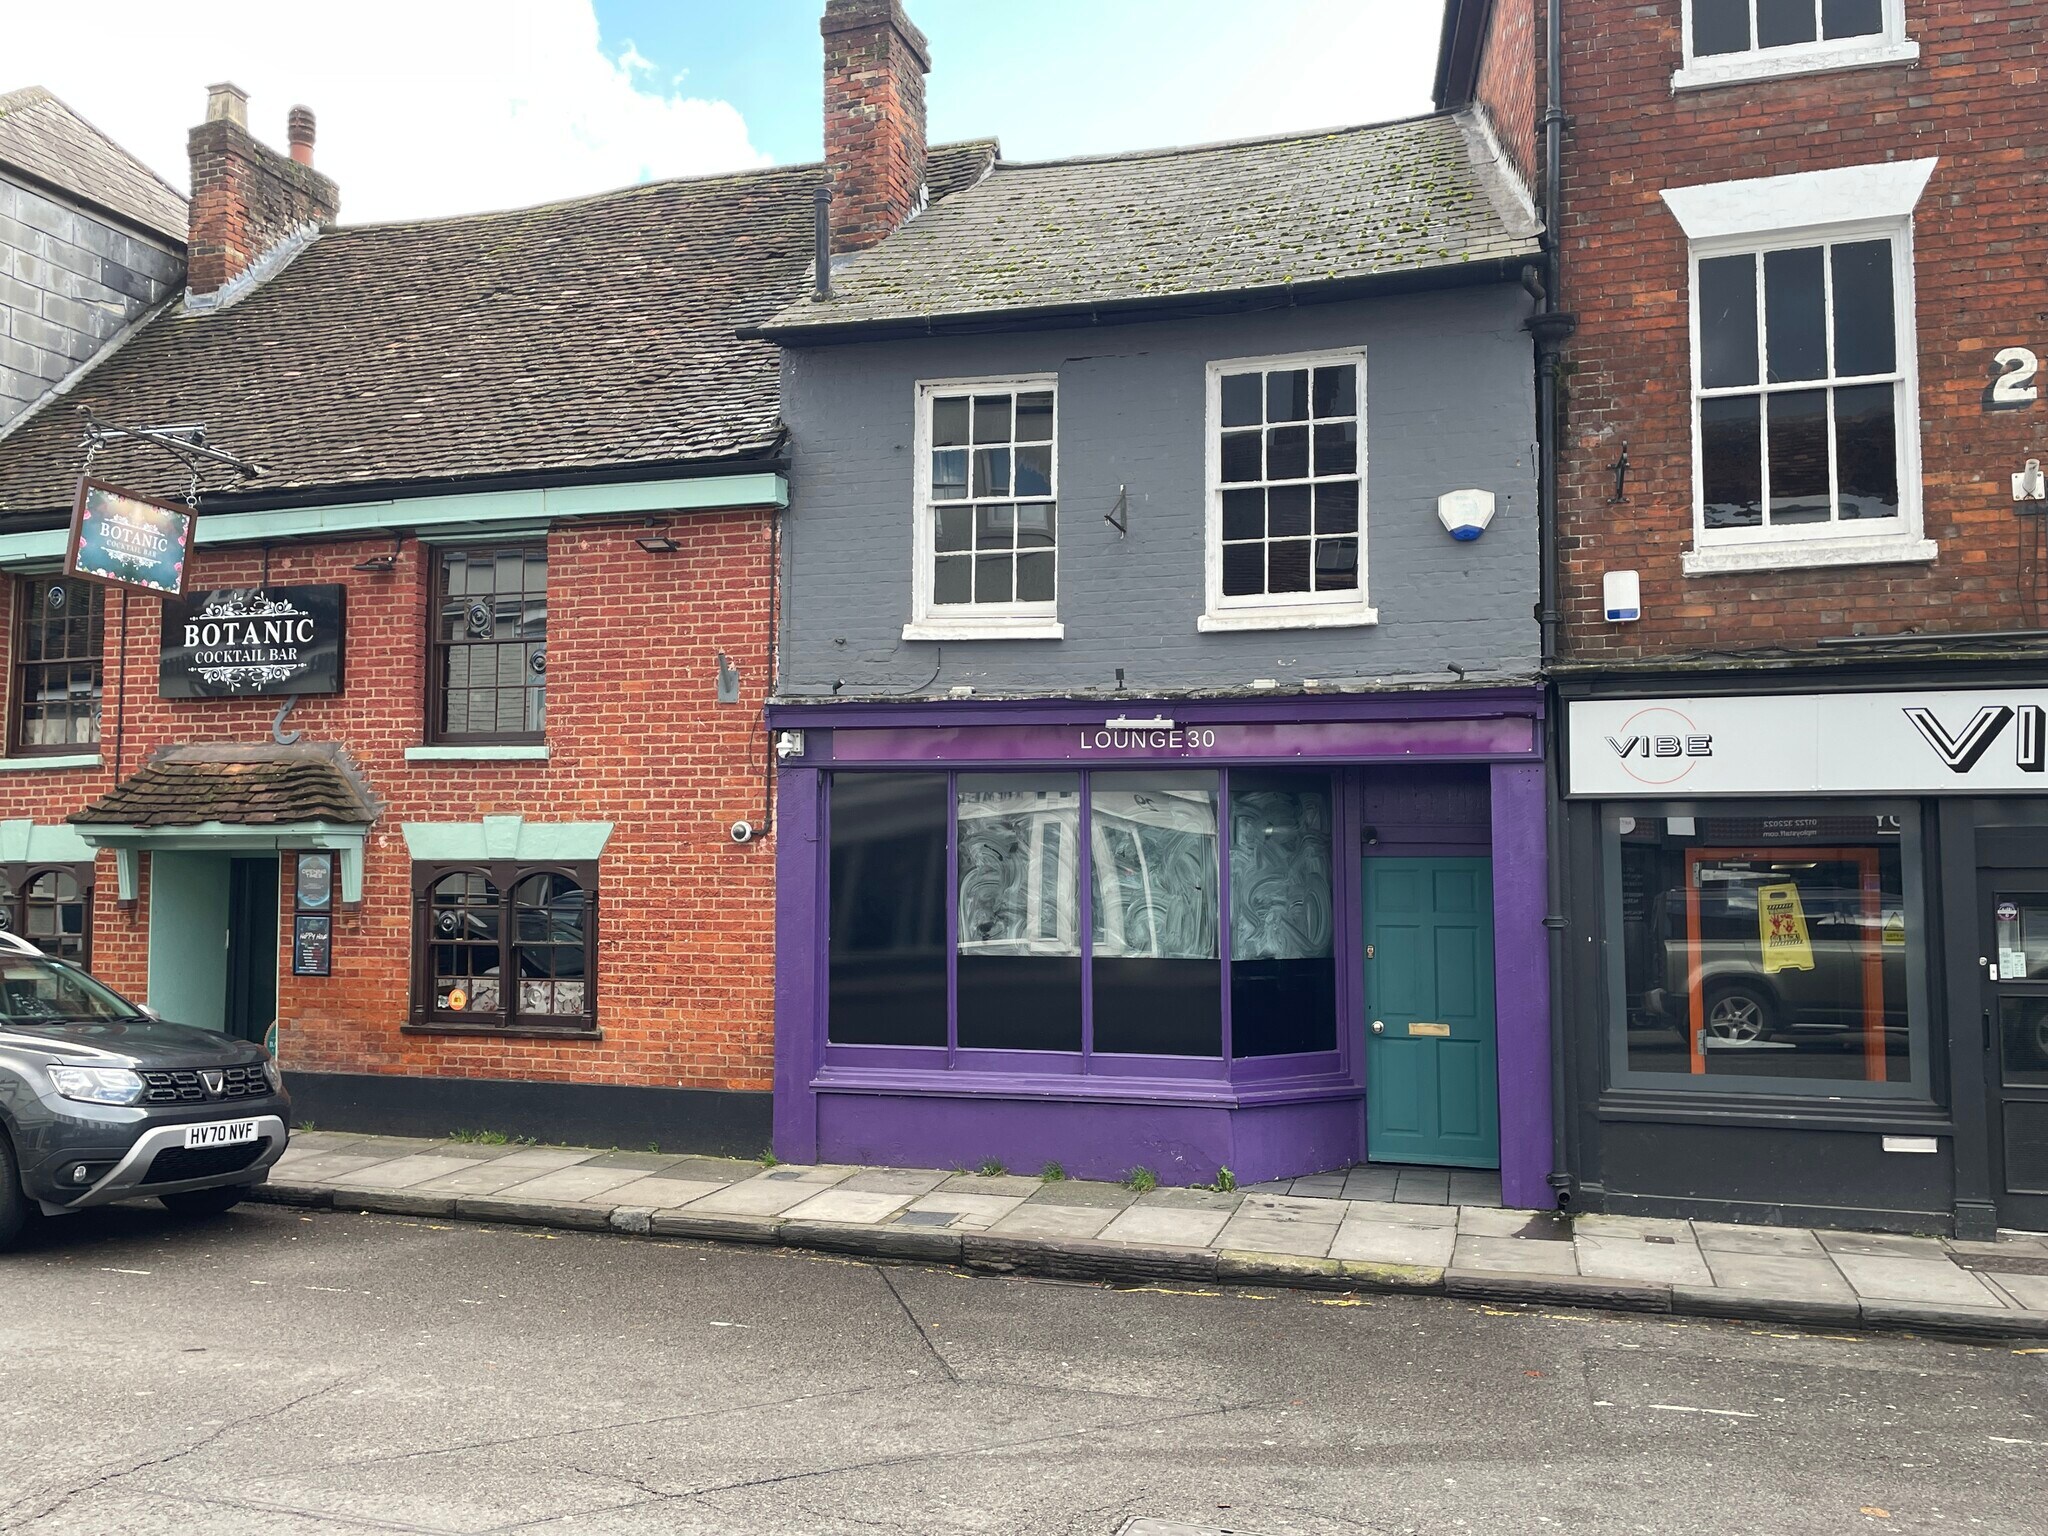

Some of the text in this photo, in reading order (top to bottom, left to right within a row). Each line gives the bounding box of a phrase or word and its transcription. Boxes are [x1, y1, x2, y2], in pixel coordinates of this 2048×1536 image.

[1993, 346, 2038, 402] 2
[100, 522, 168, 552] BOTANIC
[106, 539, 157, 559] COCKTAIL BAR
[183, 618, 314, 648] BOTANIC
[195, 647, 298, 664] COCKTAIL BAR
[1604, 733, 1713, 759] VIBE
[1901, 704, 2047, 774] VI
[191, 1123, 254, 1145] HV70 NVF
